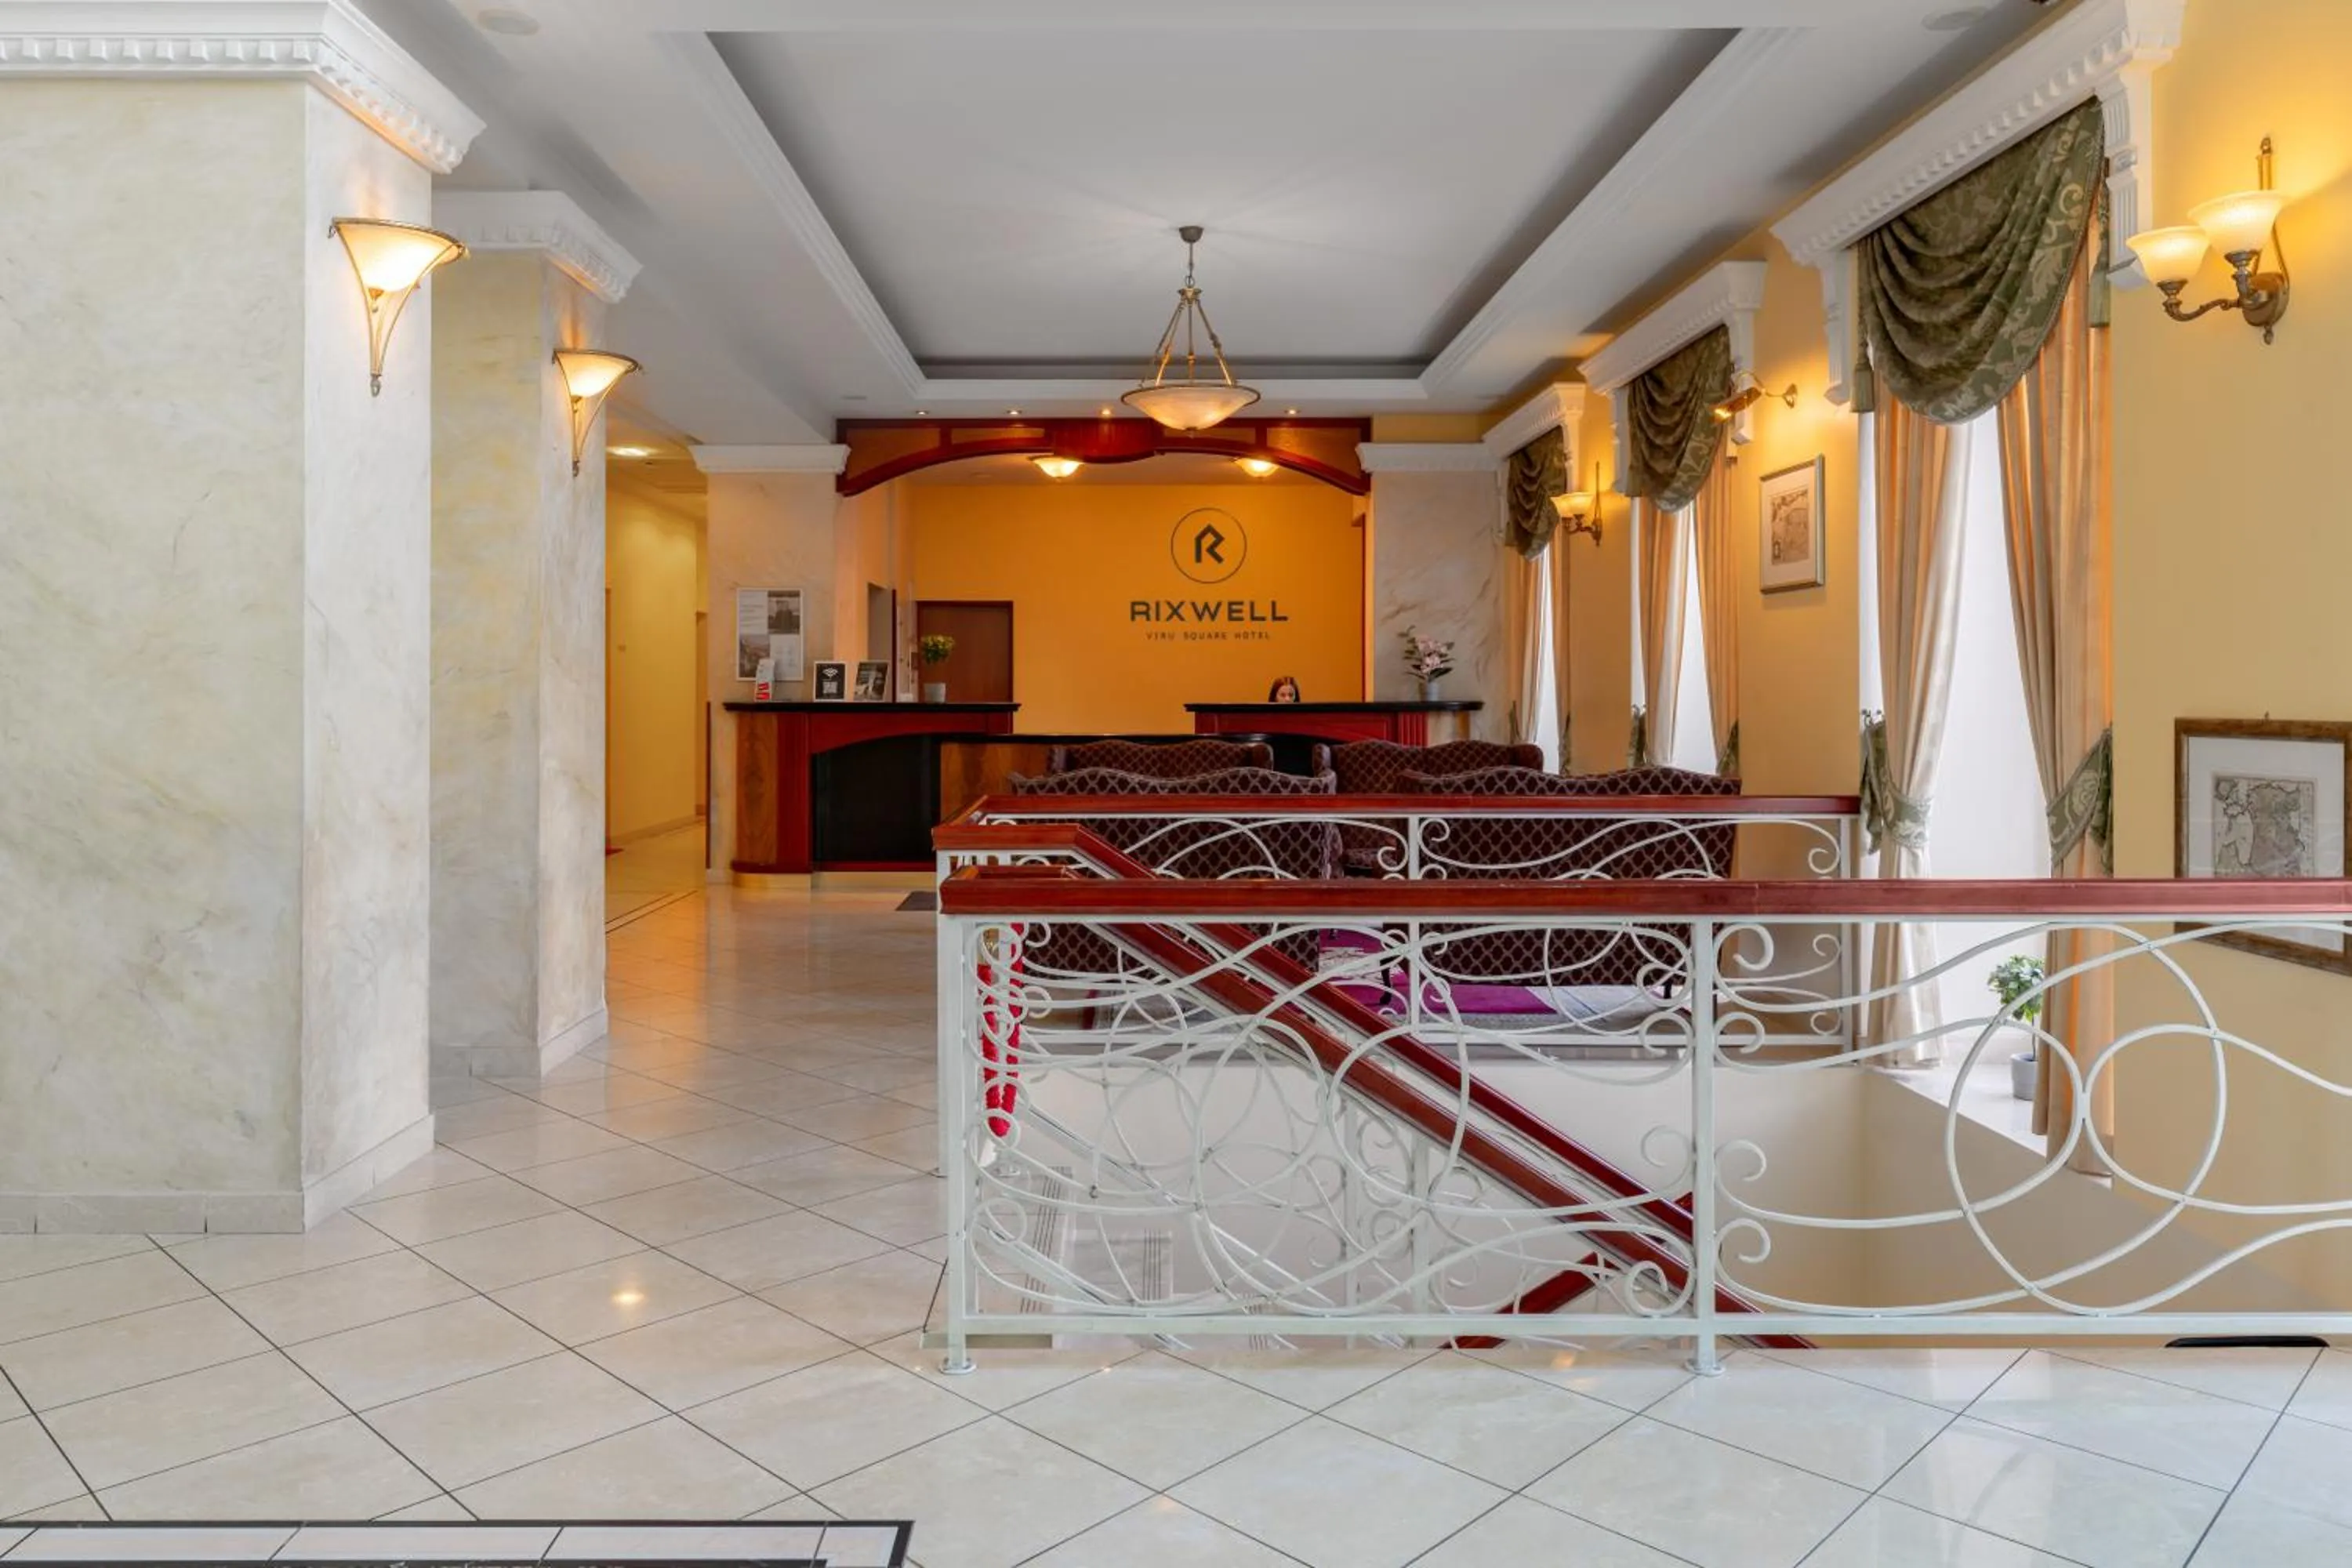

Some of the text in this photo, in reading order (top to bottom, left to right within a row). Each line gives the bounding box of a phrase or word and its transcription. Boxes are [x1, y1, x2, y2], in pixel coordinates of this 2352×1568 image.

[1195, 523, 1225, 564] R
[1130, 601, 1289, 622] RIXWELL
[1145, 631, 1270, 641] VIRU SQUARE HOTEL
